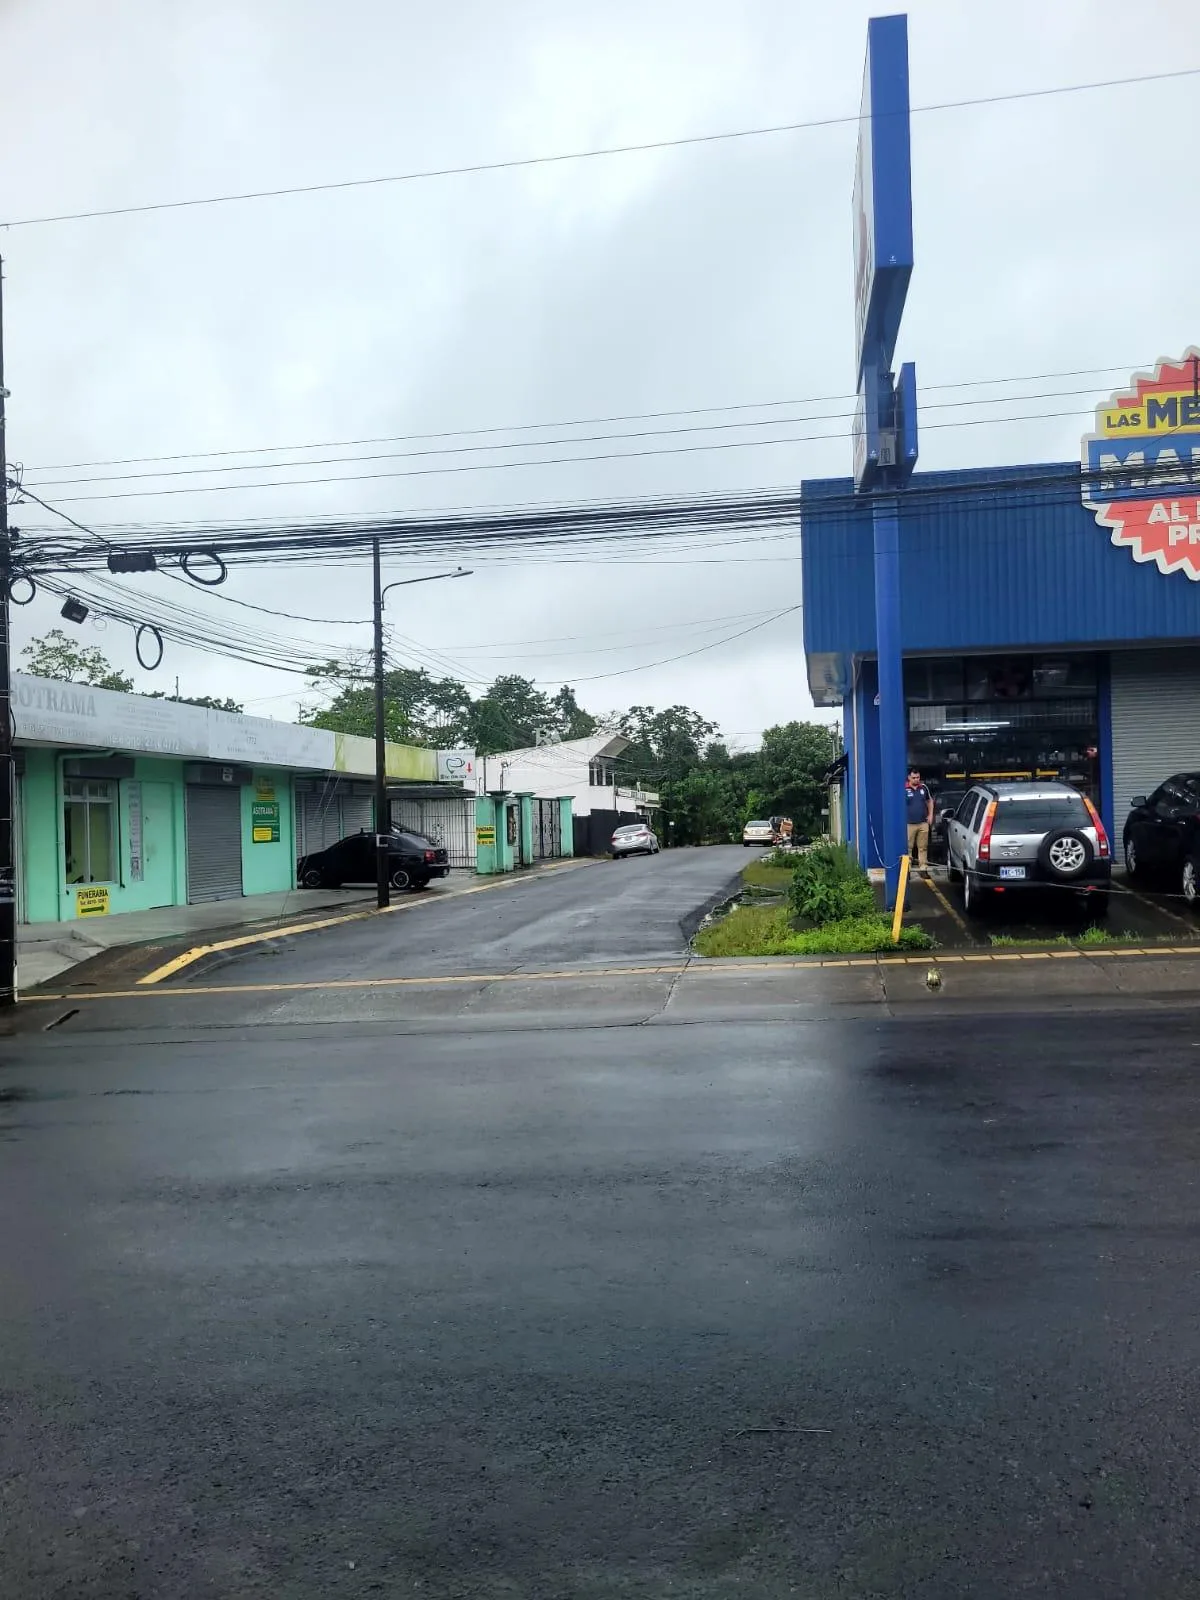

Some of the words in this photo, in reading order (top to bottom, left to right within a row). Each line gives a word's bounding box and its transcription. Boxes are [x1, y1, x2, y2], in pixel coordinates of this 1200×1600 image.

[1107, 414, 1141, 428] LAS
[1148, 502, 1188, 524] AL
[78, 889, 108, 899] FUNERARIA
